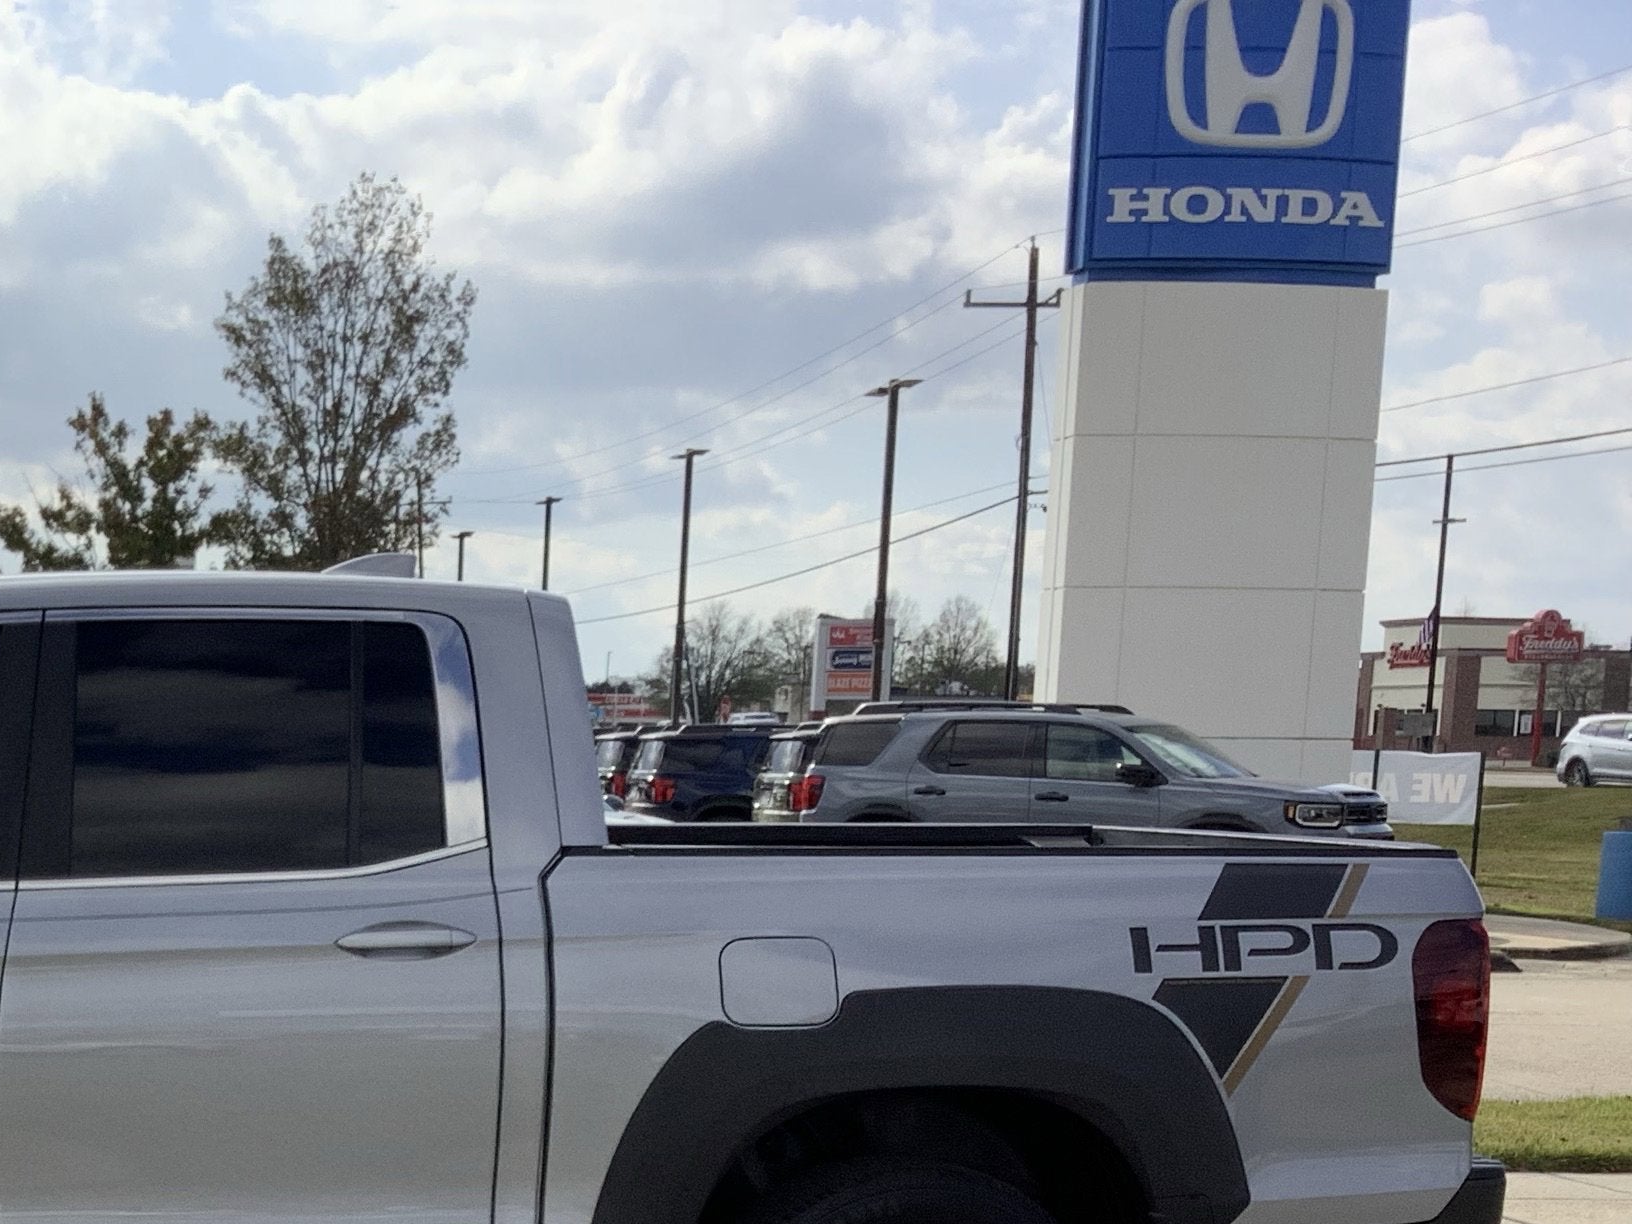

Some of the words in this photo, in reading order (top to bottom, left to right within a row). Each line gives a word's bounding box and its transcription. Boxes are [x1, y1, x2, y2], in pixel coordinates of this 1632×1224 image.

[1106, 186, 1384, 228] HONDA
[1519, 634, 1579, 653] Freddy's
[1129, 923, 1399, 974] HPD
